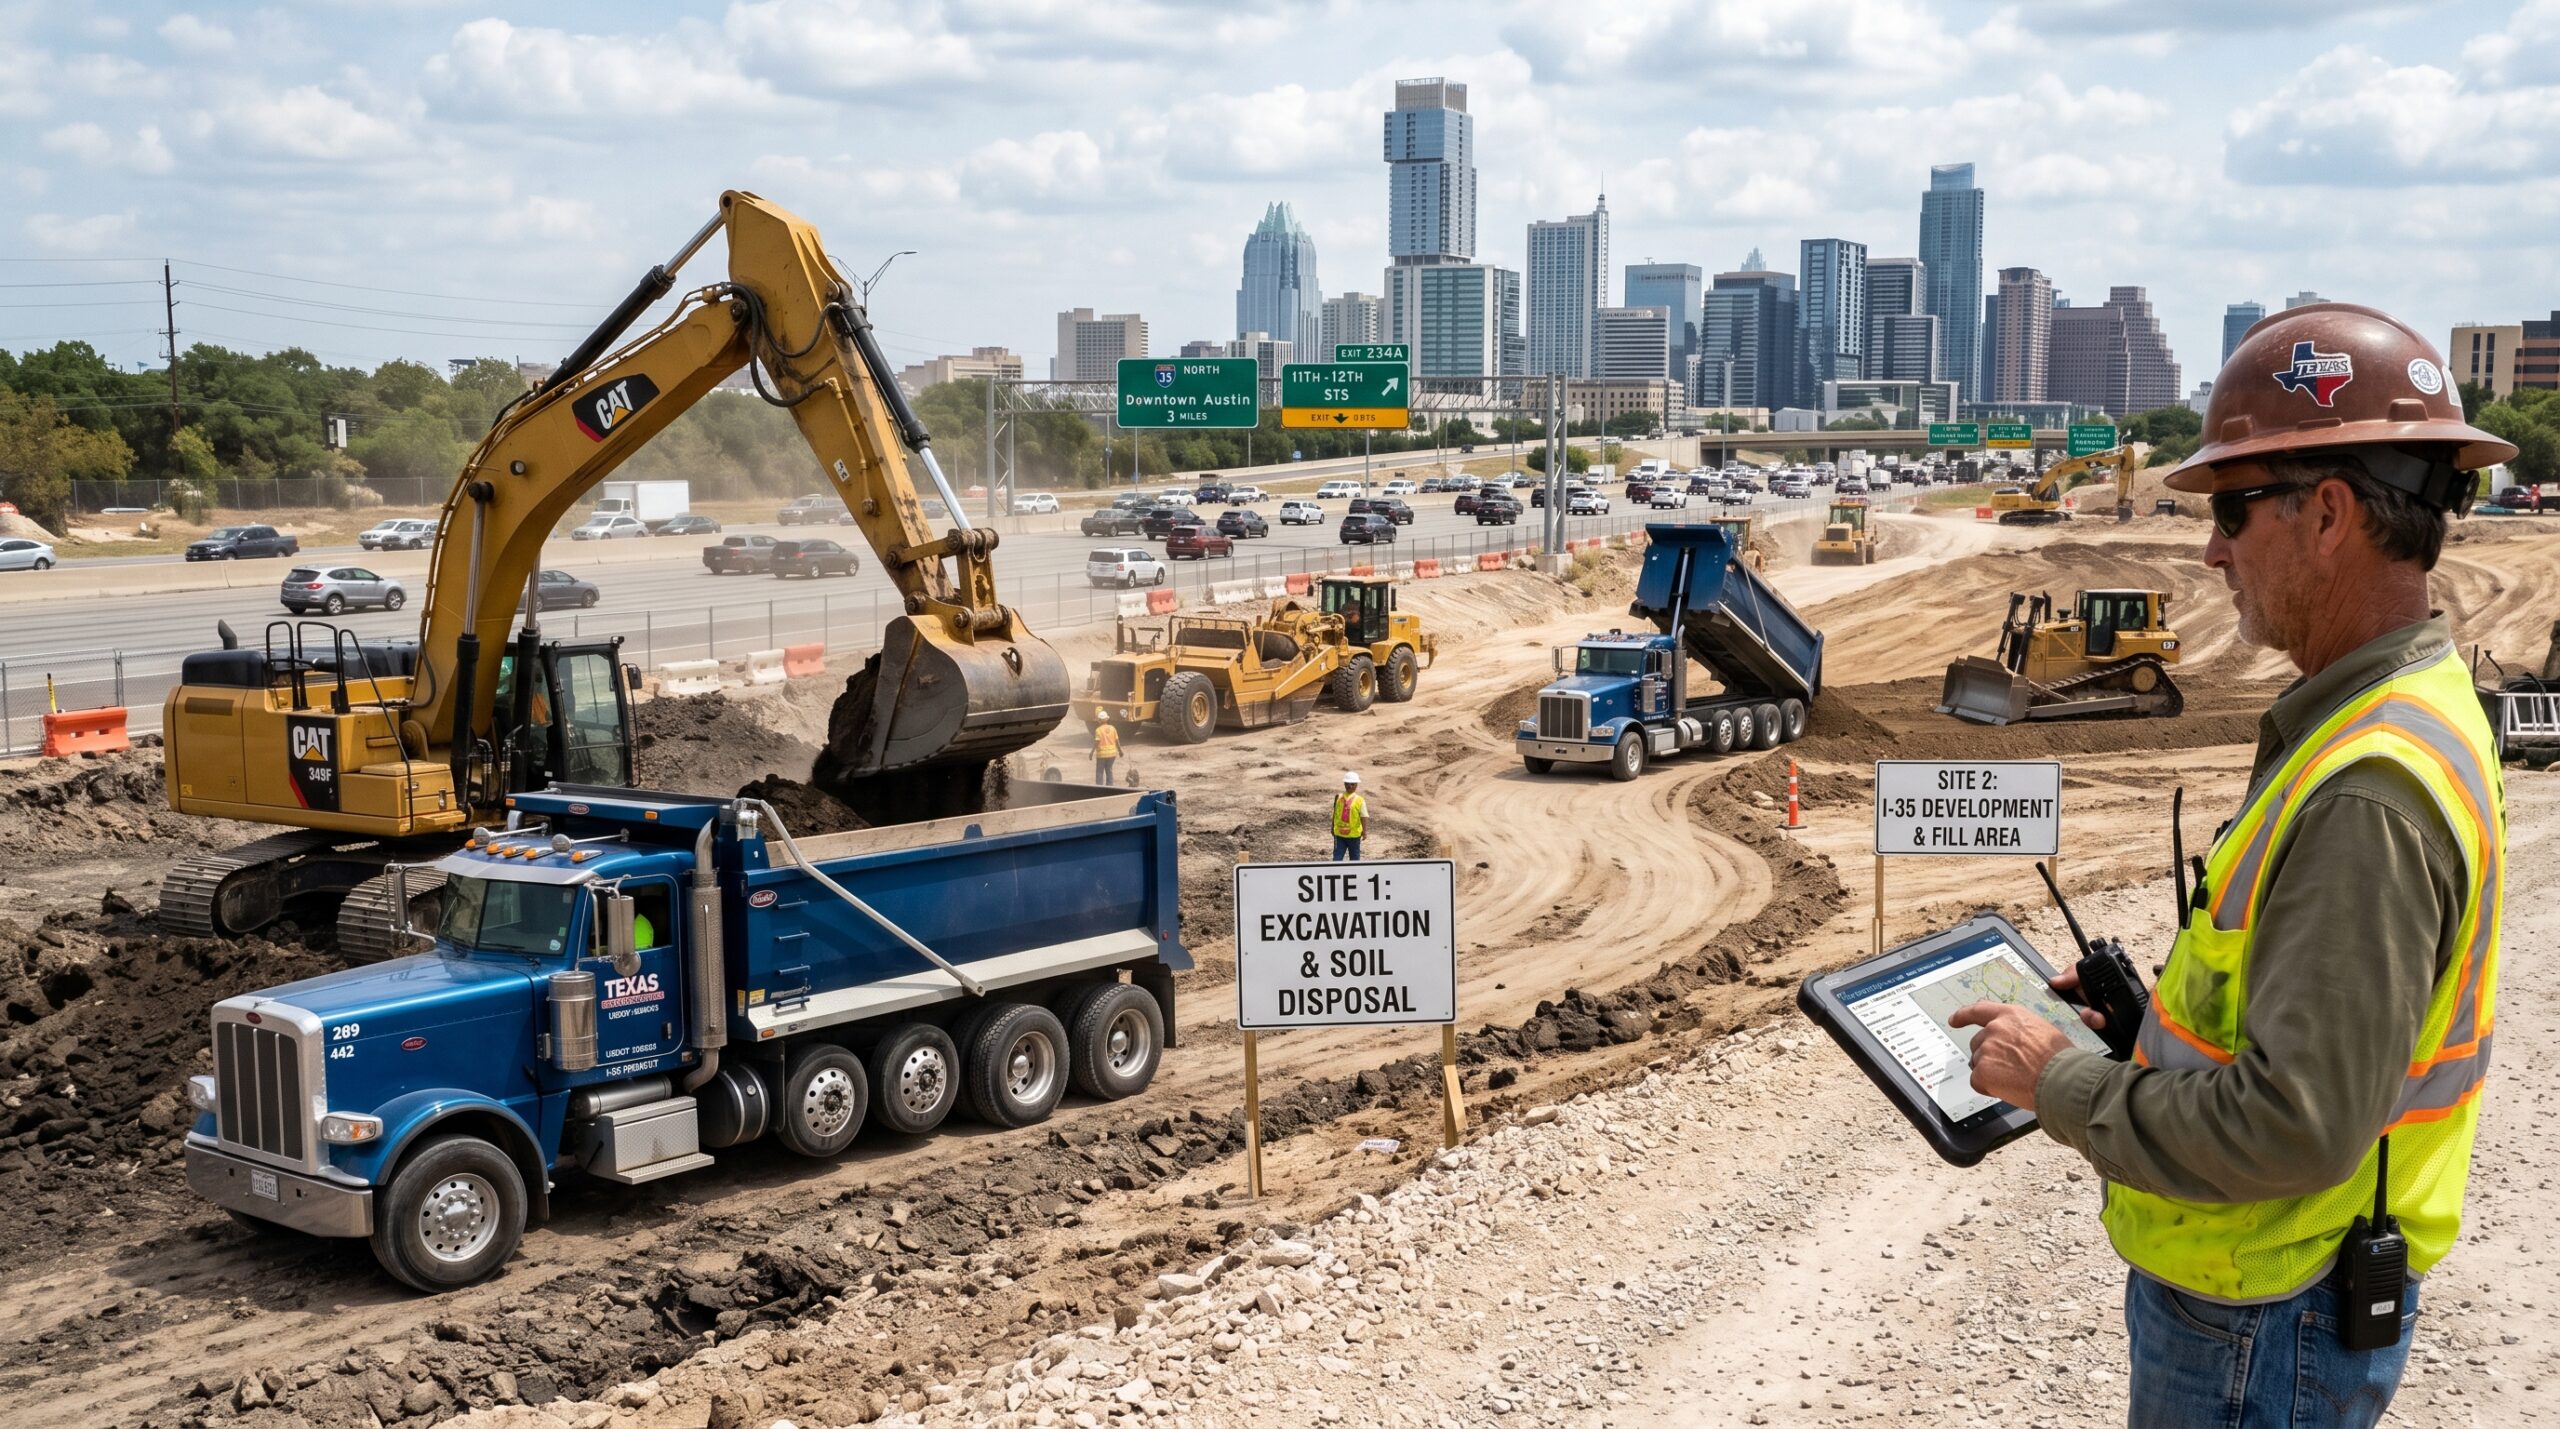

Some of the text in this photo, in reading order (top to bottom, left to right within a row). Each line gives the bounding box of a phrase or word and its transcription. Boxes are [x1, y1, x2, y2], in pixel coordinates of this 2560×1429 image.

[1341, 347, 1403, 359] EXIT 234A
[1183, 365, 1220, 375] NORTH
[1292, 371, 1321, 383] 11TH
[1332, 371, 1363, 383] 12TH
[1126, 394, 1251, 406] Downtown Austin
[1324, 389, 1349, 401] STS
[596, 380, 634, 430] CAT
[1167, 411, 1208, 423] 3 MILES
[1311, 413, 1330, 422] EXIT
[292, 725, 331, 762] CAT
[308, 767, 332, 782] 349F
[1938, 770, 1998, 790] SITE 2:
[1883, 798, 2054, 819] I-35 DEVELOPMENT
[1913, 826, 2021, 847] & FILL AREA
[1297, 873, 1391, 903] SITE 1:
[1260, 909, 1431, 942] EXCAVATION
[1300, 949, 1393, 978] & SOIL
[604, 973, 660, 999] TEXAS
[1278, 986, 1417, 1016] DISPOSAL
[332, 1023, 361, 1041] 289
[330, 1045, 355, 1060] 442
